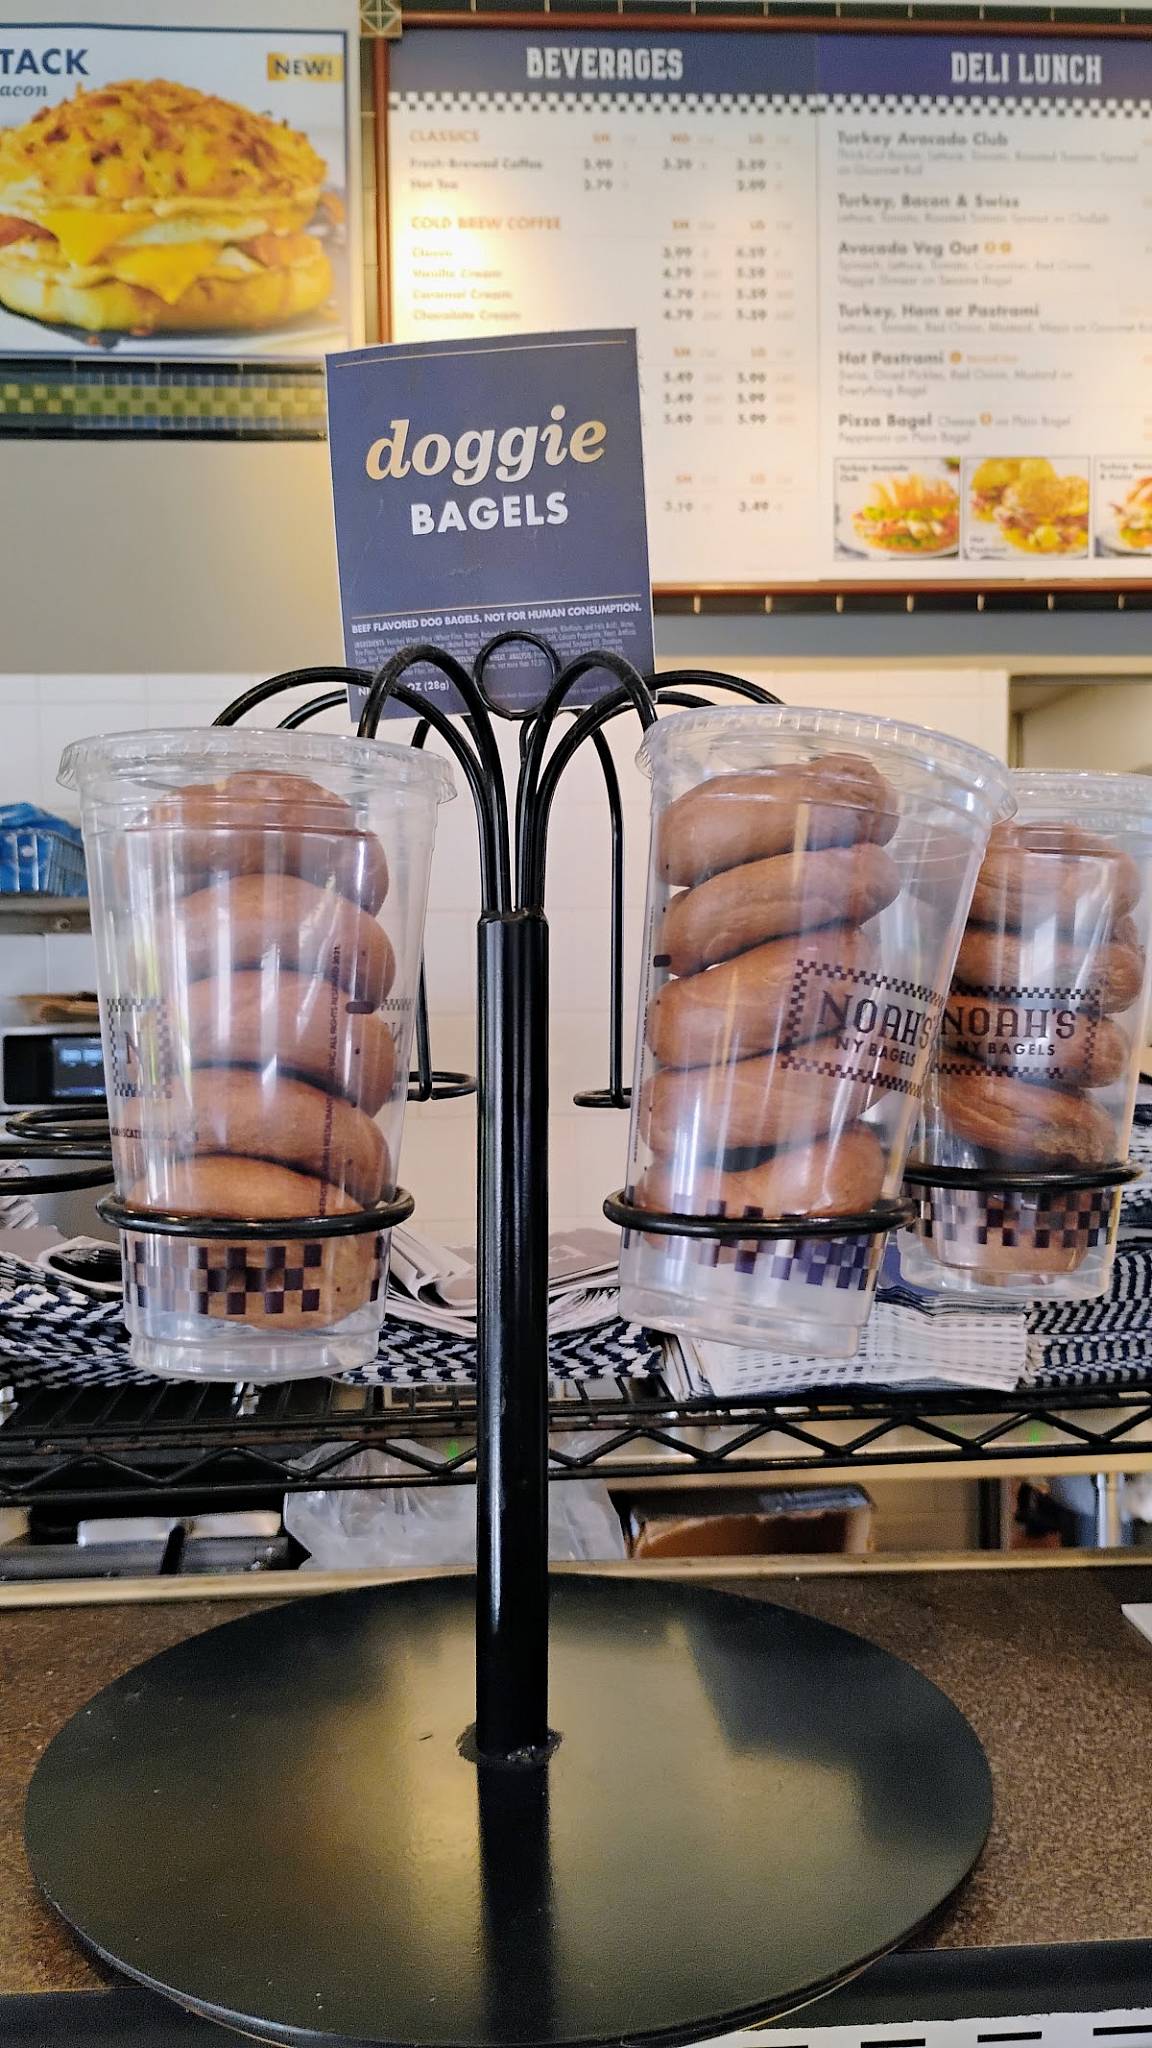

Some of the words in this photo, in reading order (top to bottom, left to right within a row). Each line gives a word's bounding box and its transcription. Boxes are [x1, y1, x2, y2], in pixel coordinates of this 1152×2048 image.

[0, 48, 89, 75] TACK
[273, 59, 333, 76] NEW!
[526, 47, 683, 80] BEVERAGES
[950, 52, 1010, 83] DELI
[1018, 53, 1102, 85] LUNCH
[0, 85, 47, 97] acon
[409, 129, 480, 143] CLASSICS
[837, 130, 891, 148] Turkey
[898, 131, 968, 145] Avocado
[973, 131, 1008, 146] Club
[837, 192, 896, 210] Turkey,
[901, 193, 949, 208] Bacon
[974, 193, 1020, 208] Swiss
[411, 216, 452, 230] COLD
[458, 216, 502, 230] BREW
[508, 216, 561, 230] COFFEE
[839, 241, 908, 255] Avocado
[913, 241, 944, 258] Veg
[950, 241, 978, 255] Out
[838, 303, 896, 319] Turkey,
[902, 303, 939, 317] Ham
[945, 306, 962, 317] or
[968, 303, 1039, 318] Pastrami
[838, 351, 866, 364] Hot
[872, 350, 944, 365] Pastrami
[839, 413, 880, 427] Pizza
[886, 413, 932, 430] Bagel
[366, 404, 607, 486] doggie
[411, 492, 569, 536] BAGELS
[351, 623, 372, 634] BEEF
[373, 619, 419, 632] FLAVORED
[420, 617, 443, 628] DOG
[444, 614, 482, 626] BAGELS.
[484, 612, 505, 623] NOT
[507, 610, 526, 621] FOR
[528, 608, 566, 619] HUMAN
[567, 602, 642, 616] CONSUMPTION.
[424, 680, 450, 692] (28g)
[818, 990, 933, 1049] NOAH'S
[941, 1007, 1076, 1039] NOAH'S
[835, 1036, 864, 1053] NY
[869, 1043, 916, 1067] BAGELS
[988, 1042, 1055, 1056] BAGELS
